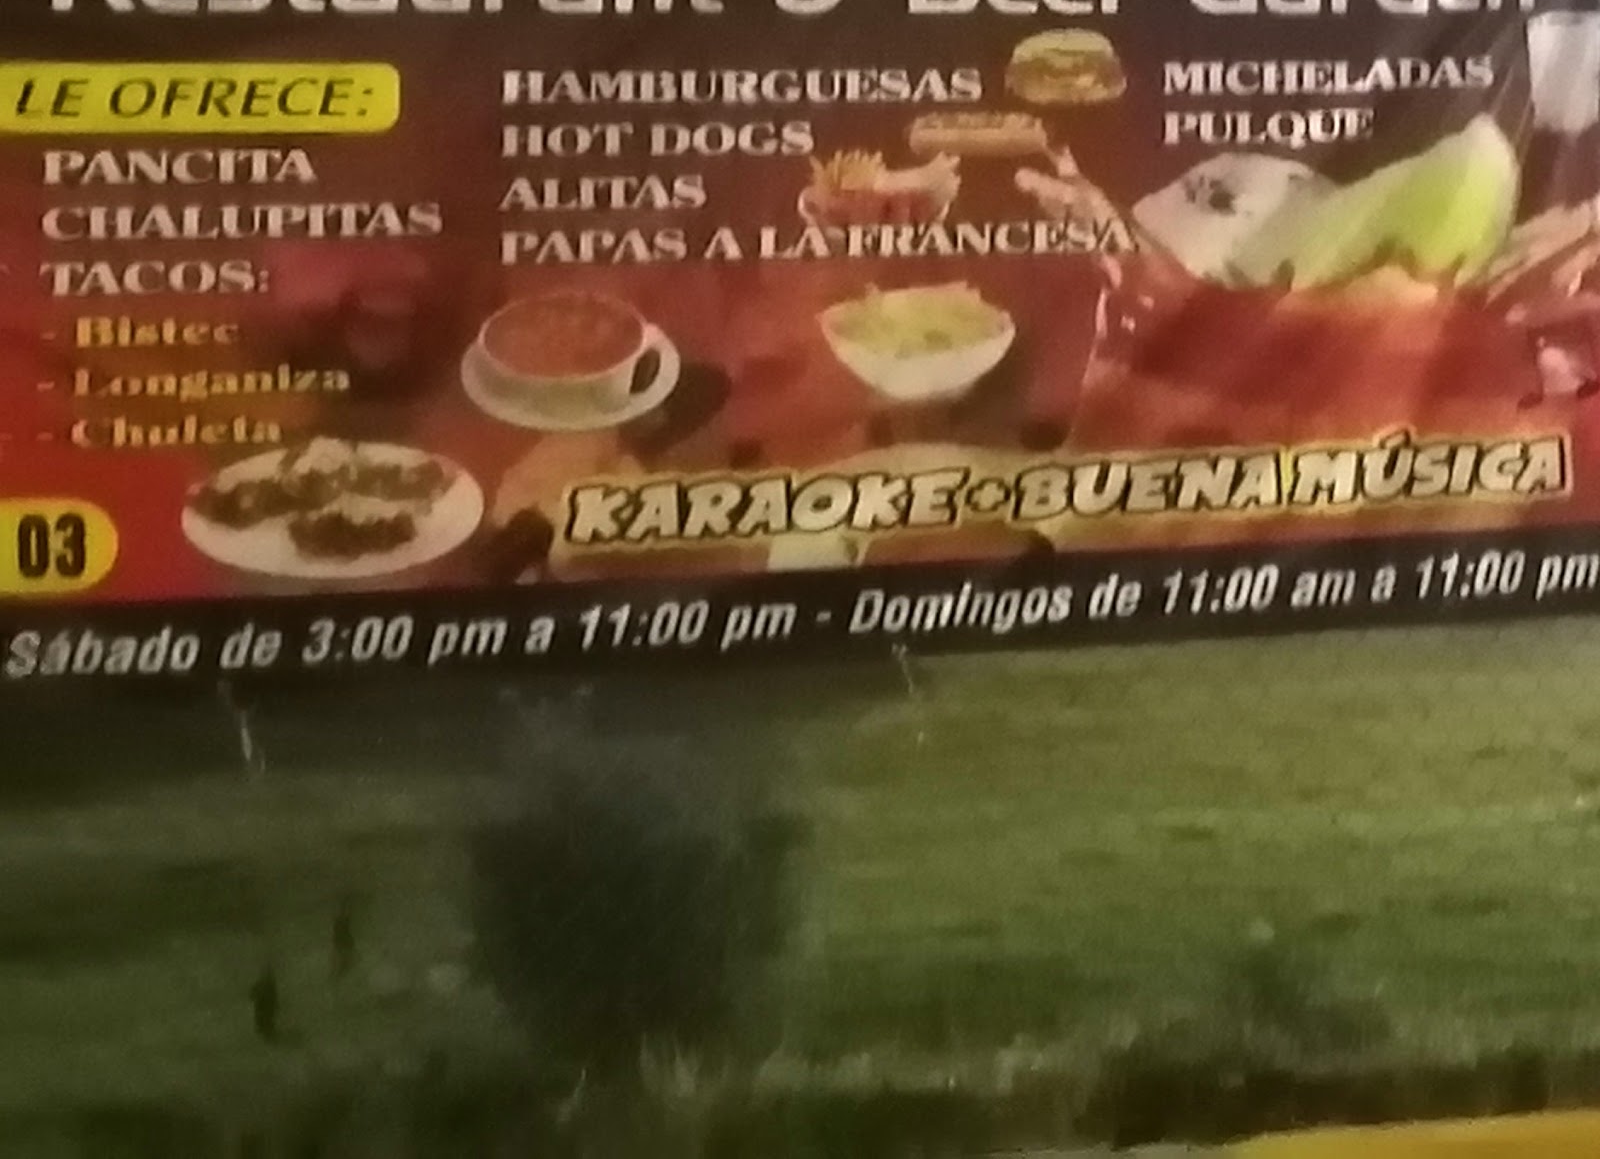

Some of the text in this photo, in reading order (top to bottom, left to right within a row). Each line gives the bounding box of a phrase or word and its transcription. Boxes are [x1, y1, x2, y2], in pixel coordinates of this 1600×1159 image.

[502, 67, 983, 105] HAMBURGUESAS
[1163, 56, 1494, 96] MICHELADAS
[15, 75, 375, 120] LE OFRECE:
[502, 120, 815, 158] HOT DOGS
[1163, 108, 1374, 148] PULQUE
[41, 147, 319, 186] PANCITA
[499, 174, 707, 211] ALITAS
[40, 201, 444, 241] CHALUPITAS
[501, 218, 1142, 265] PAPAS A LA FRANCESA
[39, 258, 271, 298] TACOS:
[75, 315, 240, 349] Bistec
[73, 362, 351, 403] Longaniza
[71, 413, 284, 449] Chuleta
[566, 466, 968, 543] KARAOKE
[1010, 449, 1284, 521] BUENA
[1287, 426, 1570, 511] MÚSICA
[17, 515, 87, 578] 03
[6, 625, 200, 679] Sábado
[219, 622, 283, 669] de
[302, 615, 414, 664] 3:00
[428, 617, 508, 667] pm
[525, 617, 556, 655] a
[579, 599, 709, 648] 11:00
[720, 602, 797, 651] pm
[849, 581, 1073, 635] Domingos
[1088, 573, 1142, 619] de
[1162, 564, 1279, 615] 11:00
[1291, 565, 1356, 609] am
[1370, 565, 1397, 601] a
[1416, 551, 1525, 599] 11:00
[1536, 551, 1600, 602] pm
